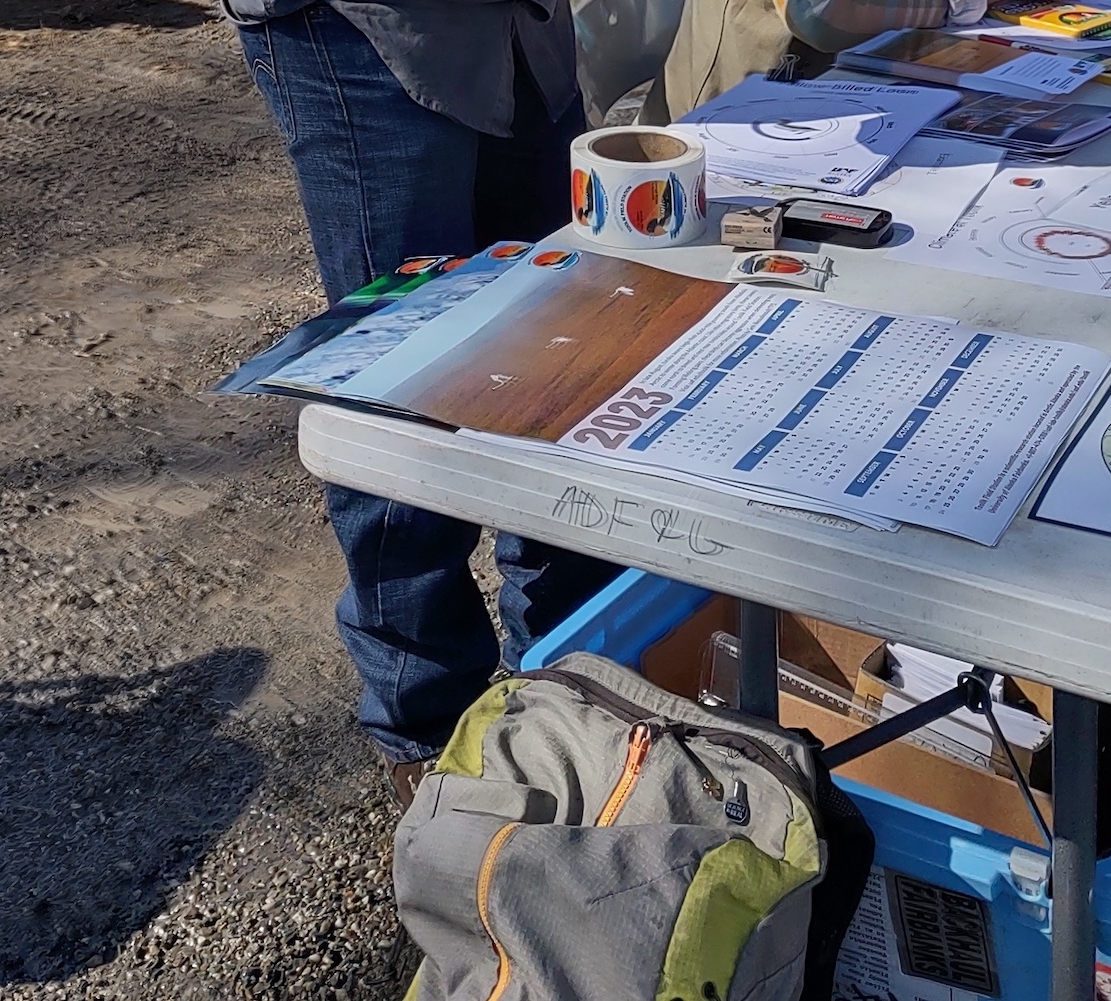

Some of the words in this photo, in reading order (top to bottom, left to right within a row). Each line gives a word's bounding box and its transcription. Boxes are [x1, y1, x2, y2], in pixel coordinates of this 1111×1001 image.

[771, 309, 785, 321] APRIL
[733, 345, 749, 359] MARCH
[961, 340, 980, 360] DECEMBER
[831, 364, 844, 376] JULY
[689, 380, 711, 401] FEBRUARY
[929, 378, 950, 398] NOVEMBER
[572, 386, 674, 450] 2023
[645, 419, 666, 438] JANUARY
[896, 420, 916, 440] OCTOBER
[752, 444, 766, 455] MAY
[856, 460, 882, 484] SEPTEMBER
[901, 880, 948, 977] FAIRBANKS
[939, 891, 987, 987] BACKHAUL
